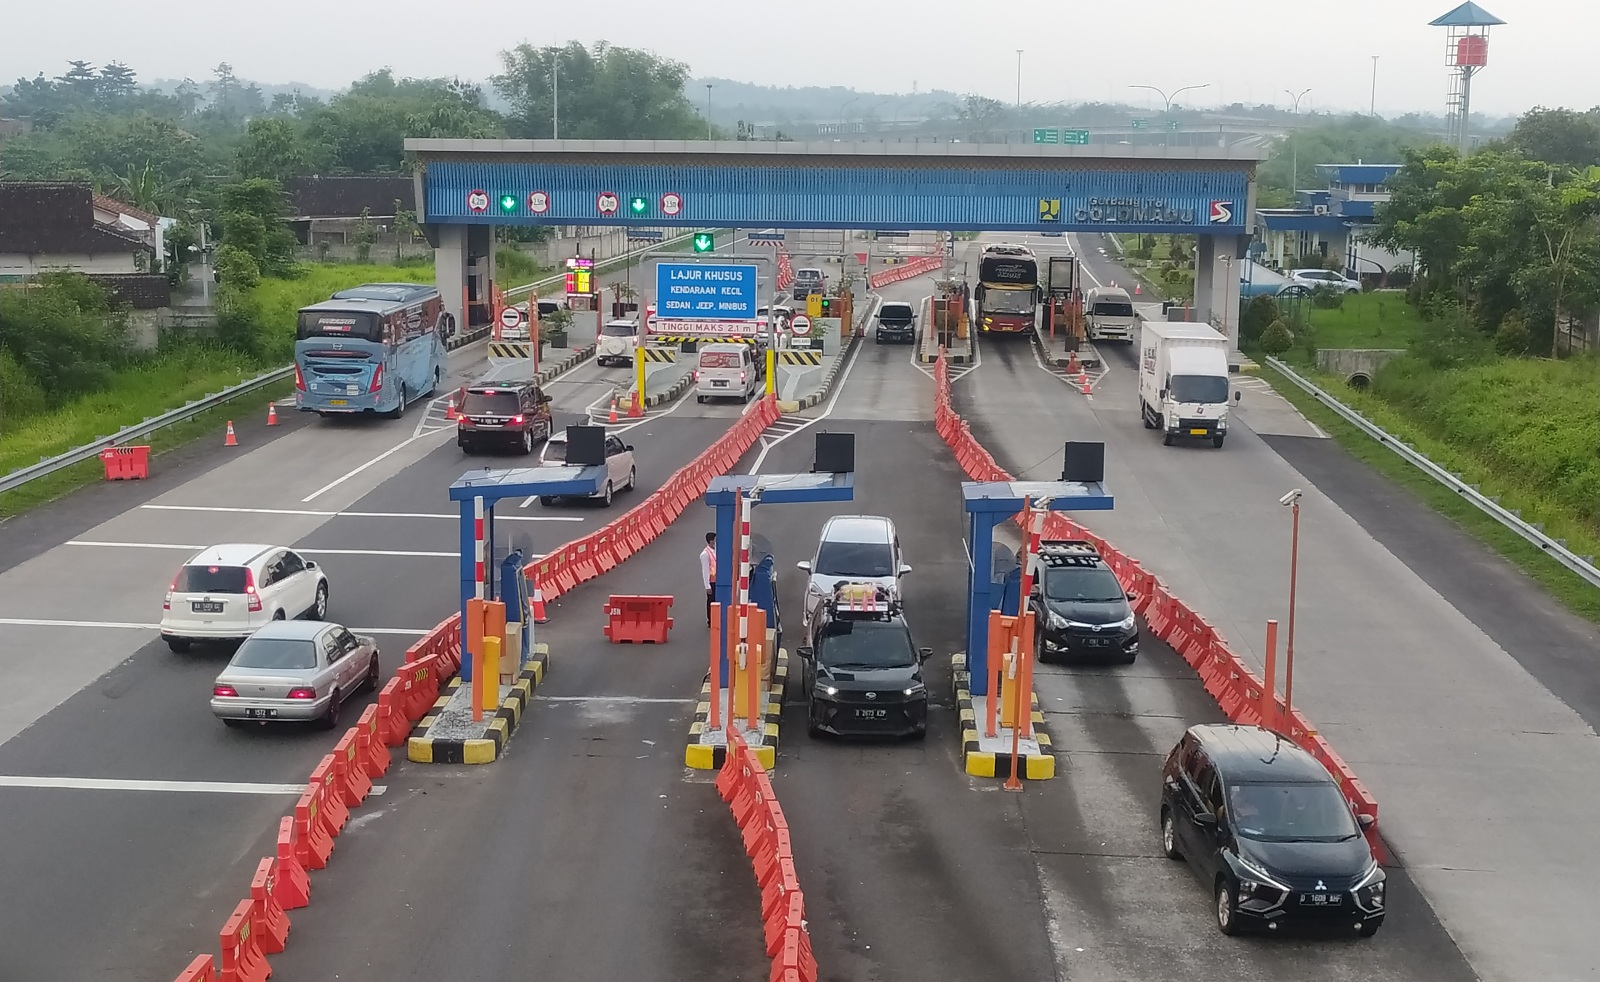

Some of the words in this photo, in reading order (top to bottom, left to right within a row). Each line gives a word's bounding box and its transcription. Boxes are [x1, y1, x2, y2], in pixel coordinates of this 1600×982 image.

[1075, 208, 1194, 222] COLOMADU
[670, 270, 701, 280] LAJUR
[704, 271, 743, 281] KHUSUS
[670, 286, 716, 295] KENDARAAN
[721, 287, 742, 295] KECIL
[718, 303, 747, 311] MINIBUS
[662, 323, 692, 331] TINGGI
[695, 323, 724, 332] MAKS
[727, 324, 739, 332] 2.1
